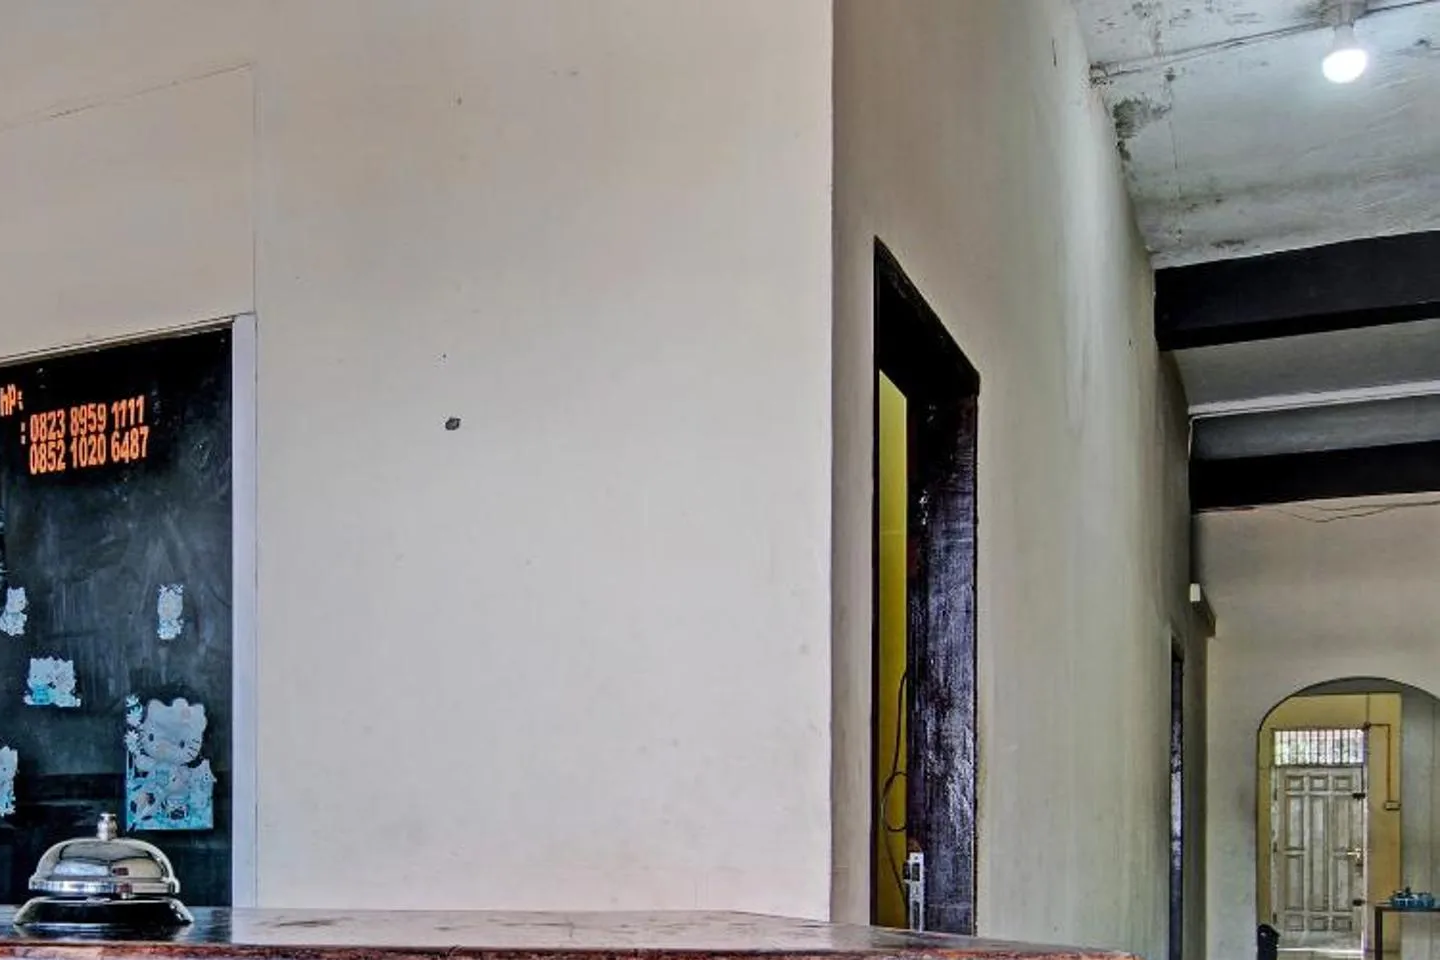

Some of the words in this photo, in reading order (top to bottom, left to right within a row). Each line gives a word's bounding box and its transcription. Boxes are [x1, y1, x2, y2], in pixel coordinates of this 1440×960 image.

[30, 409, 65, 442] 0823
[70, 403, 106, 437] 8959
[111, 395, 145, 429] 1111
[30, 439, 66, 475] 0852
[70, 433, 106, 469] 1020
[111, 426, 149, 463] 6487
